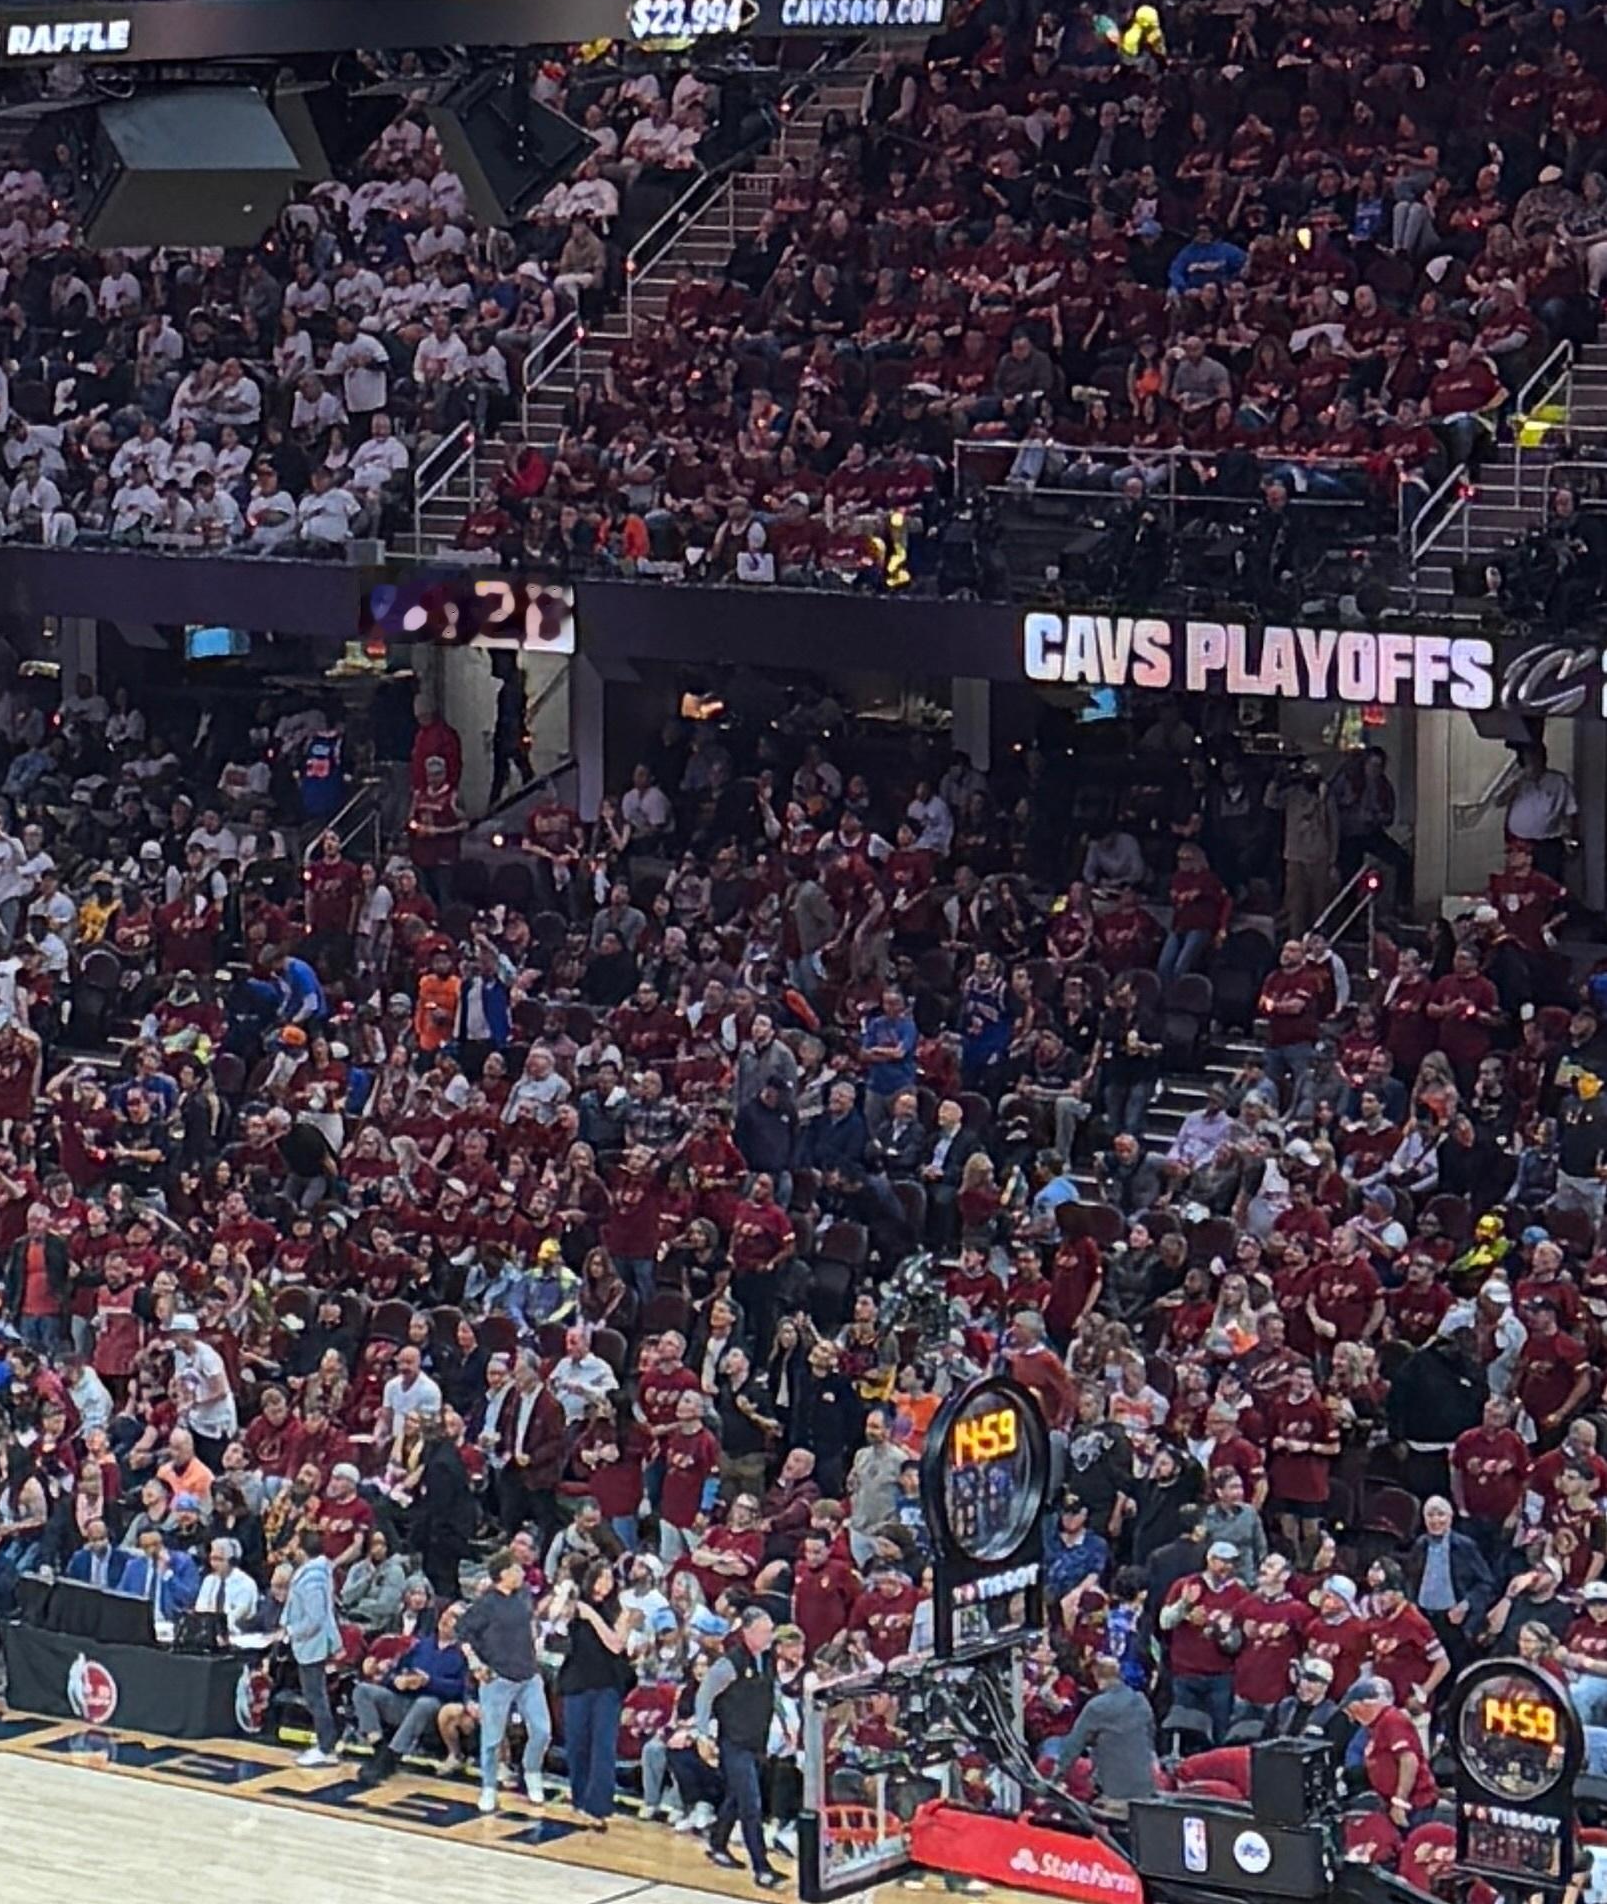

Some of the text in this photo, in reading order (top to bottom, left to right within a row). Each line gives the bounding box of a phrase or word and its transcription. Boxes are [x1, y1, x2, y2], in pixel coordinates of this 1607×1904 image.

[7, 20, 131, 55] RAFFLE
[1023, 611, 1494, 710] CAVS PLAYOFFS
